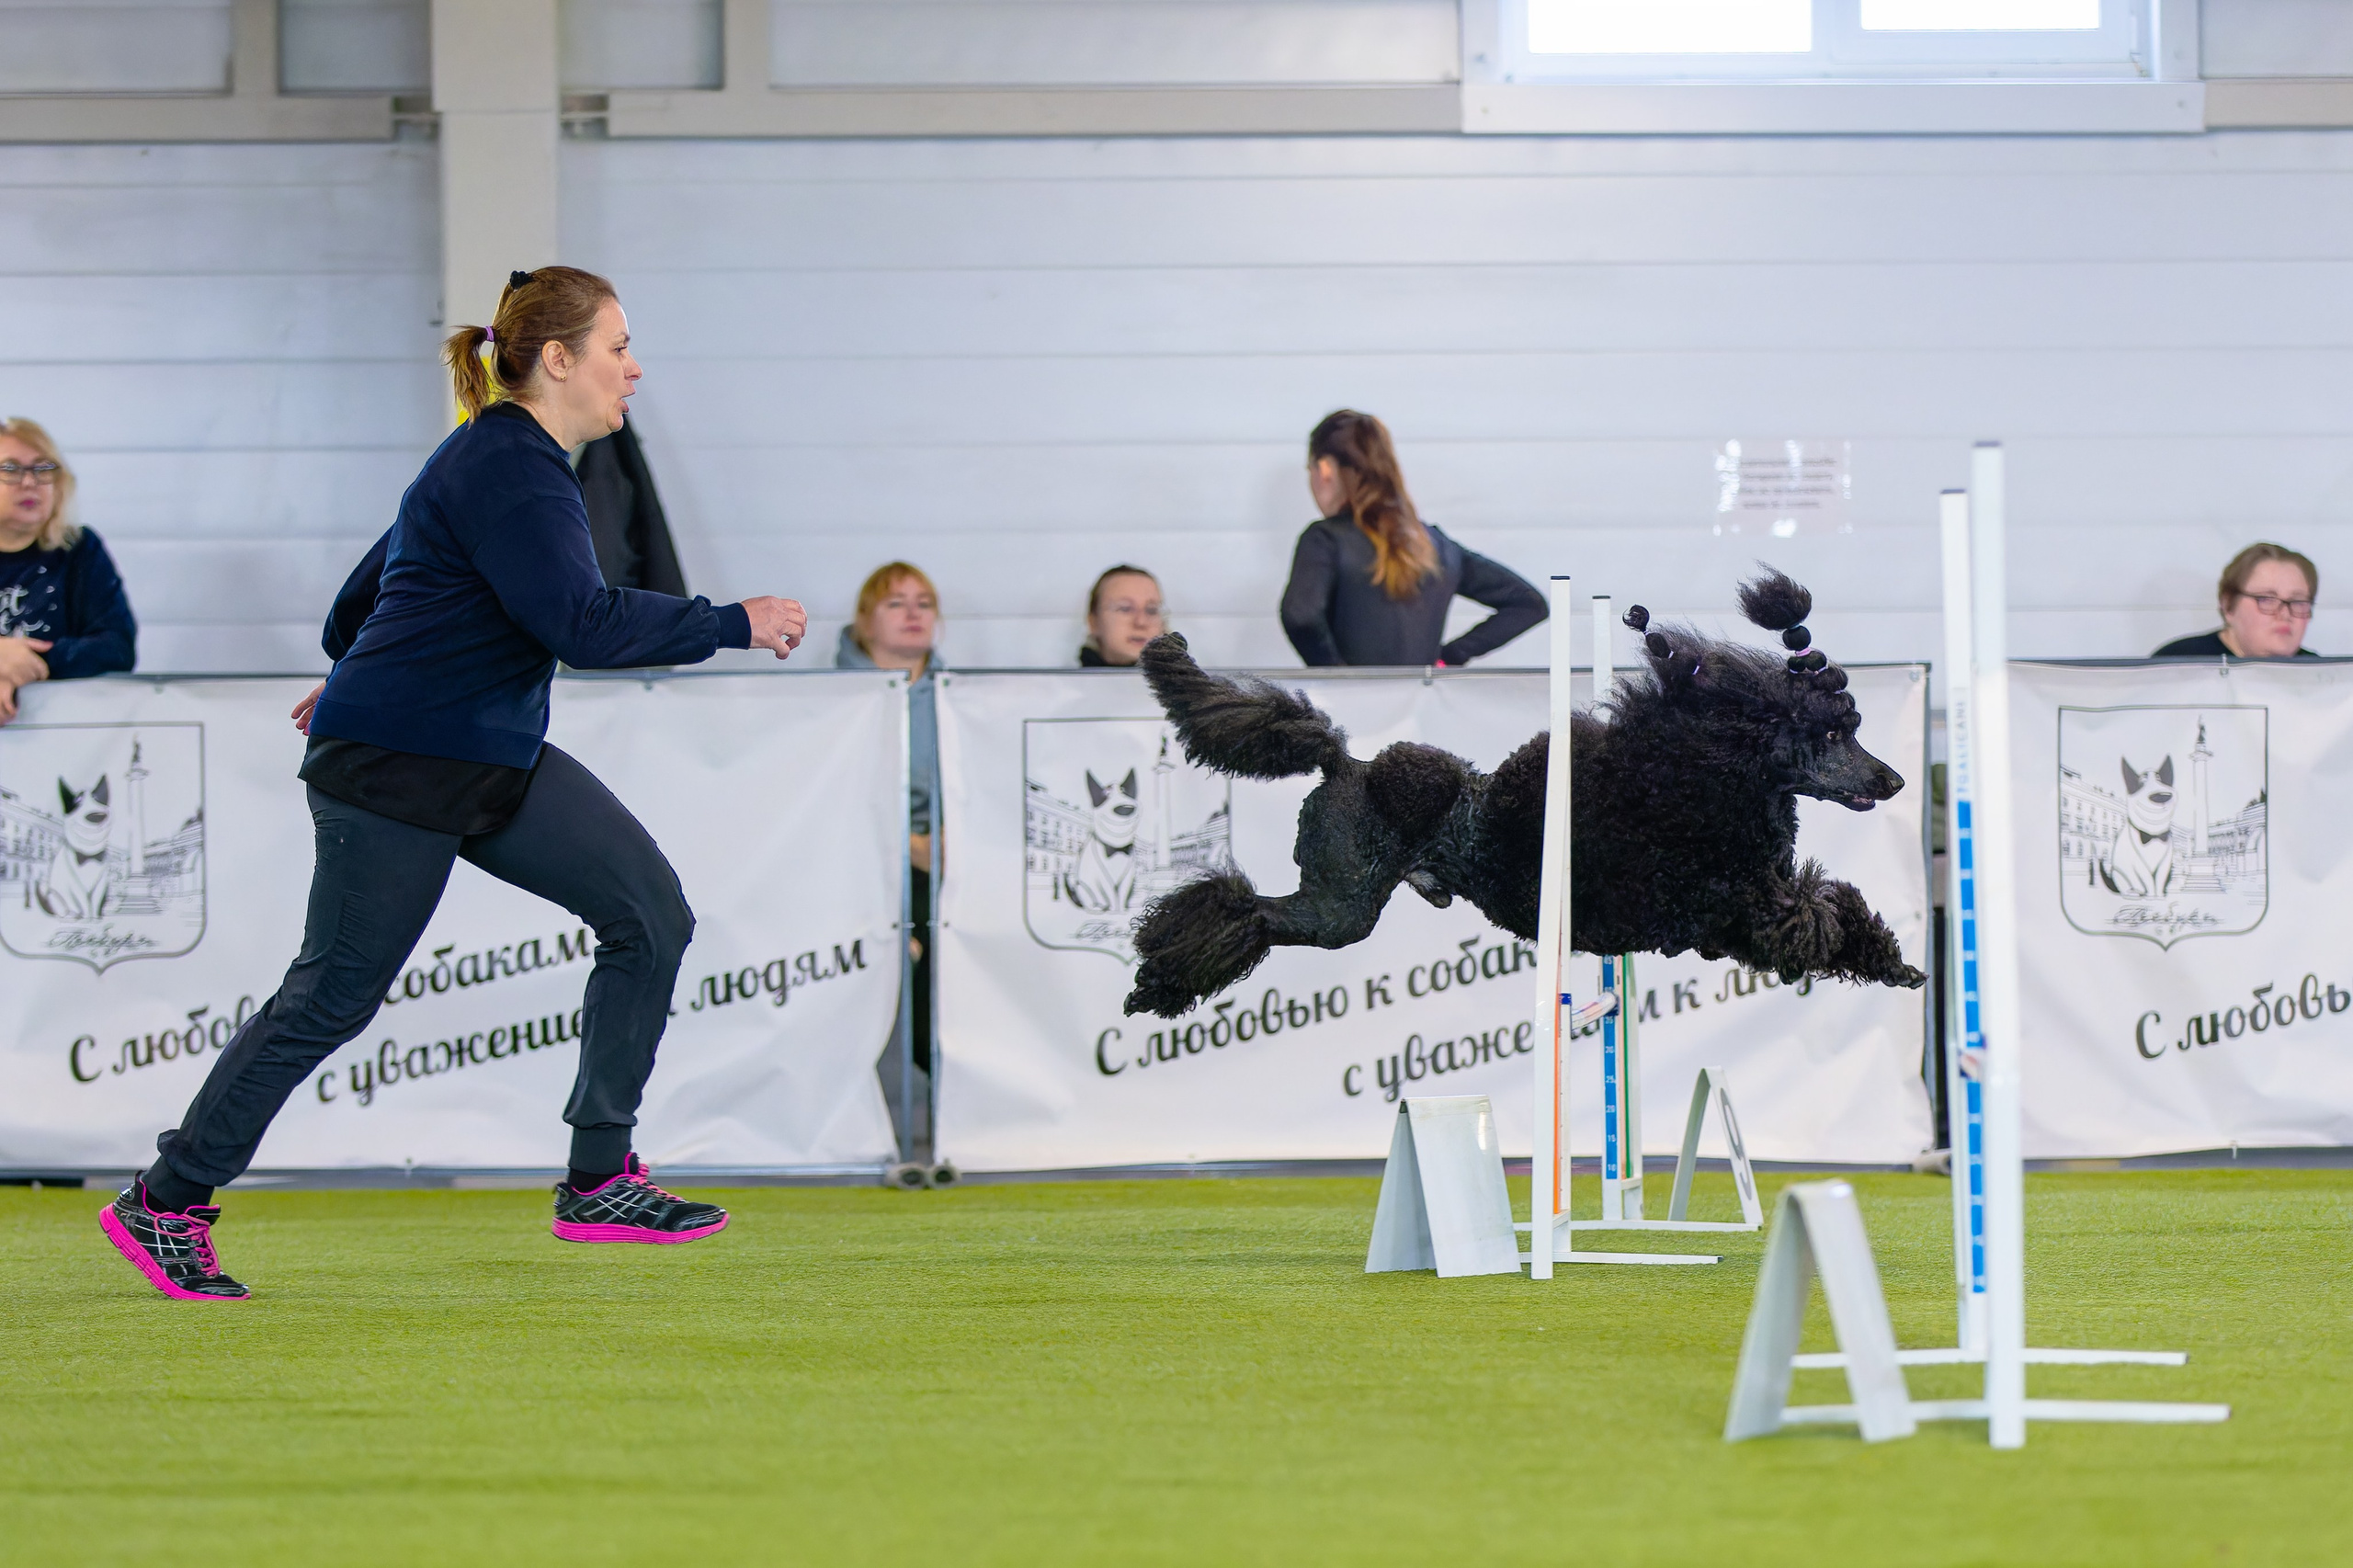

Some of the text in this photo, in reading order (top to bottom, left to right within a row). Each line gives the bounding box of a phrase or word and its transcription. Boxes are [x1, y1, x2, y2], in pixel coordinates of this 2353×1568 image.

[112, 995, 255, 1074] любо
[350, 1006, 582, 1106] уважени
[691, 939, 867, 1007] людям
[1095, 935, 1538, 1076] С любовью к собак
[2177, 974, 2352, 1051] любовь
